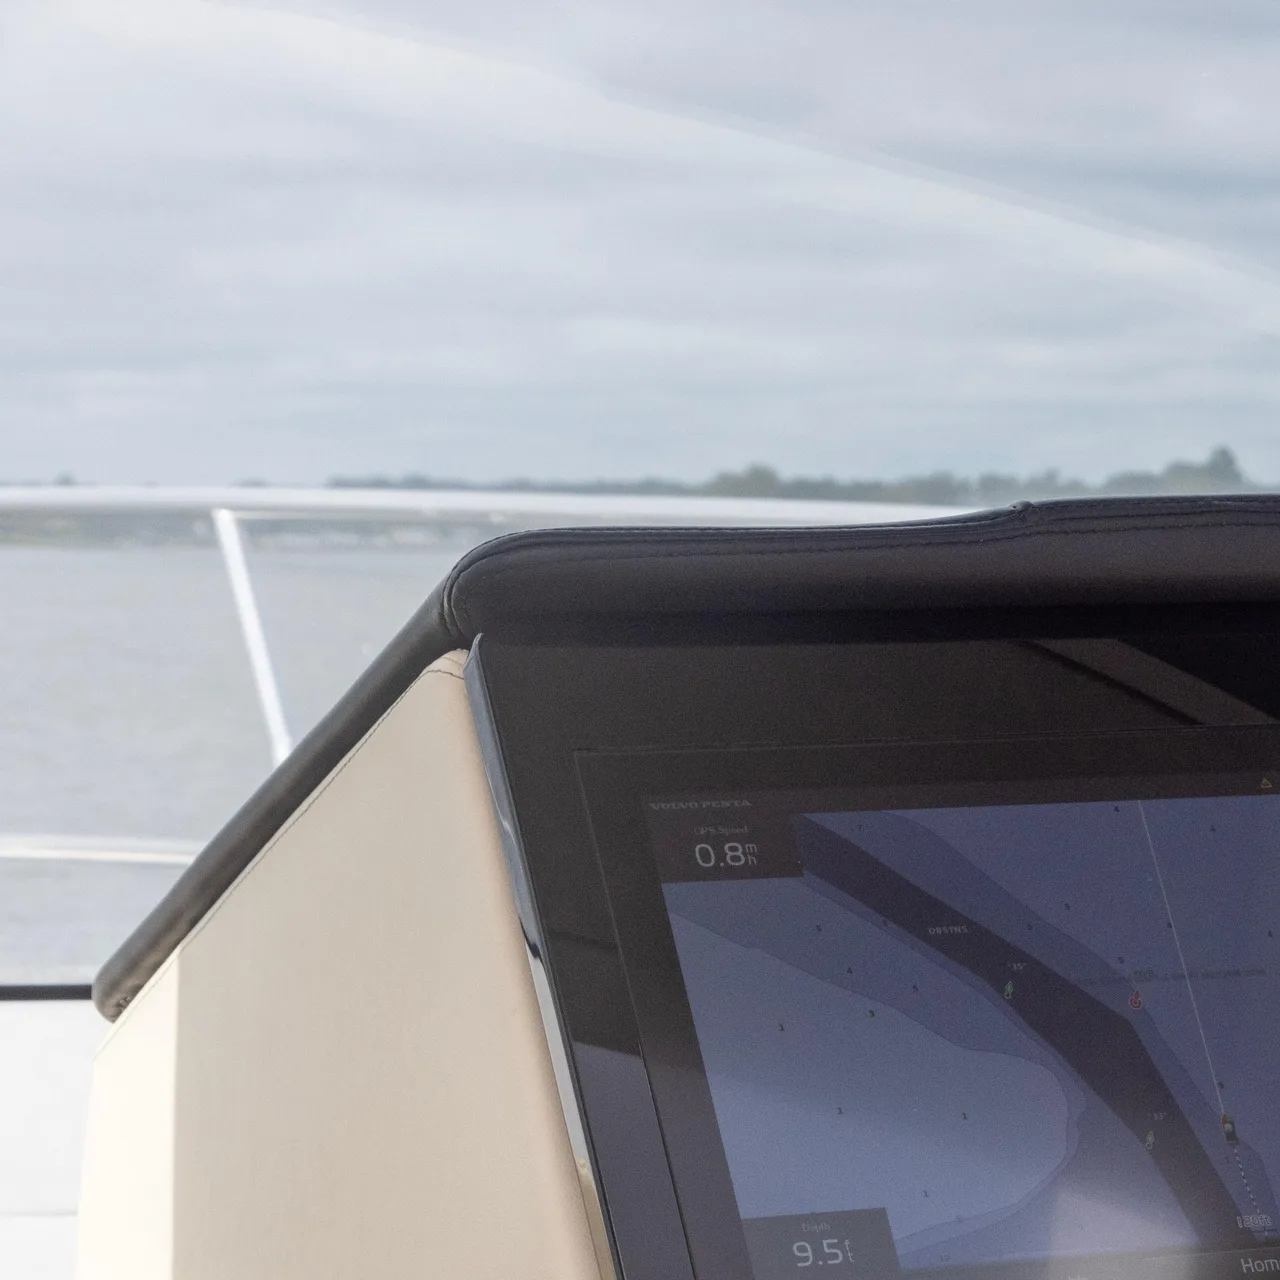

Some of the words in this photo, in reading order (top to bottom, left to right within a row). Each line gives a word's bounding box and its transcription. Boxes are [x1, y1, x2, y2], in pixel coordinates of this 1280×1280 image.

[648, 802, 701, 811] VOLVO
[702, 799, 753, 809] PENTA
[695, 842, 745, 867] 0.8
[928, 924, 969, 937] OBSTNS
[792, 1238, 844, 1267] 9.5
